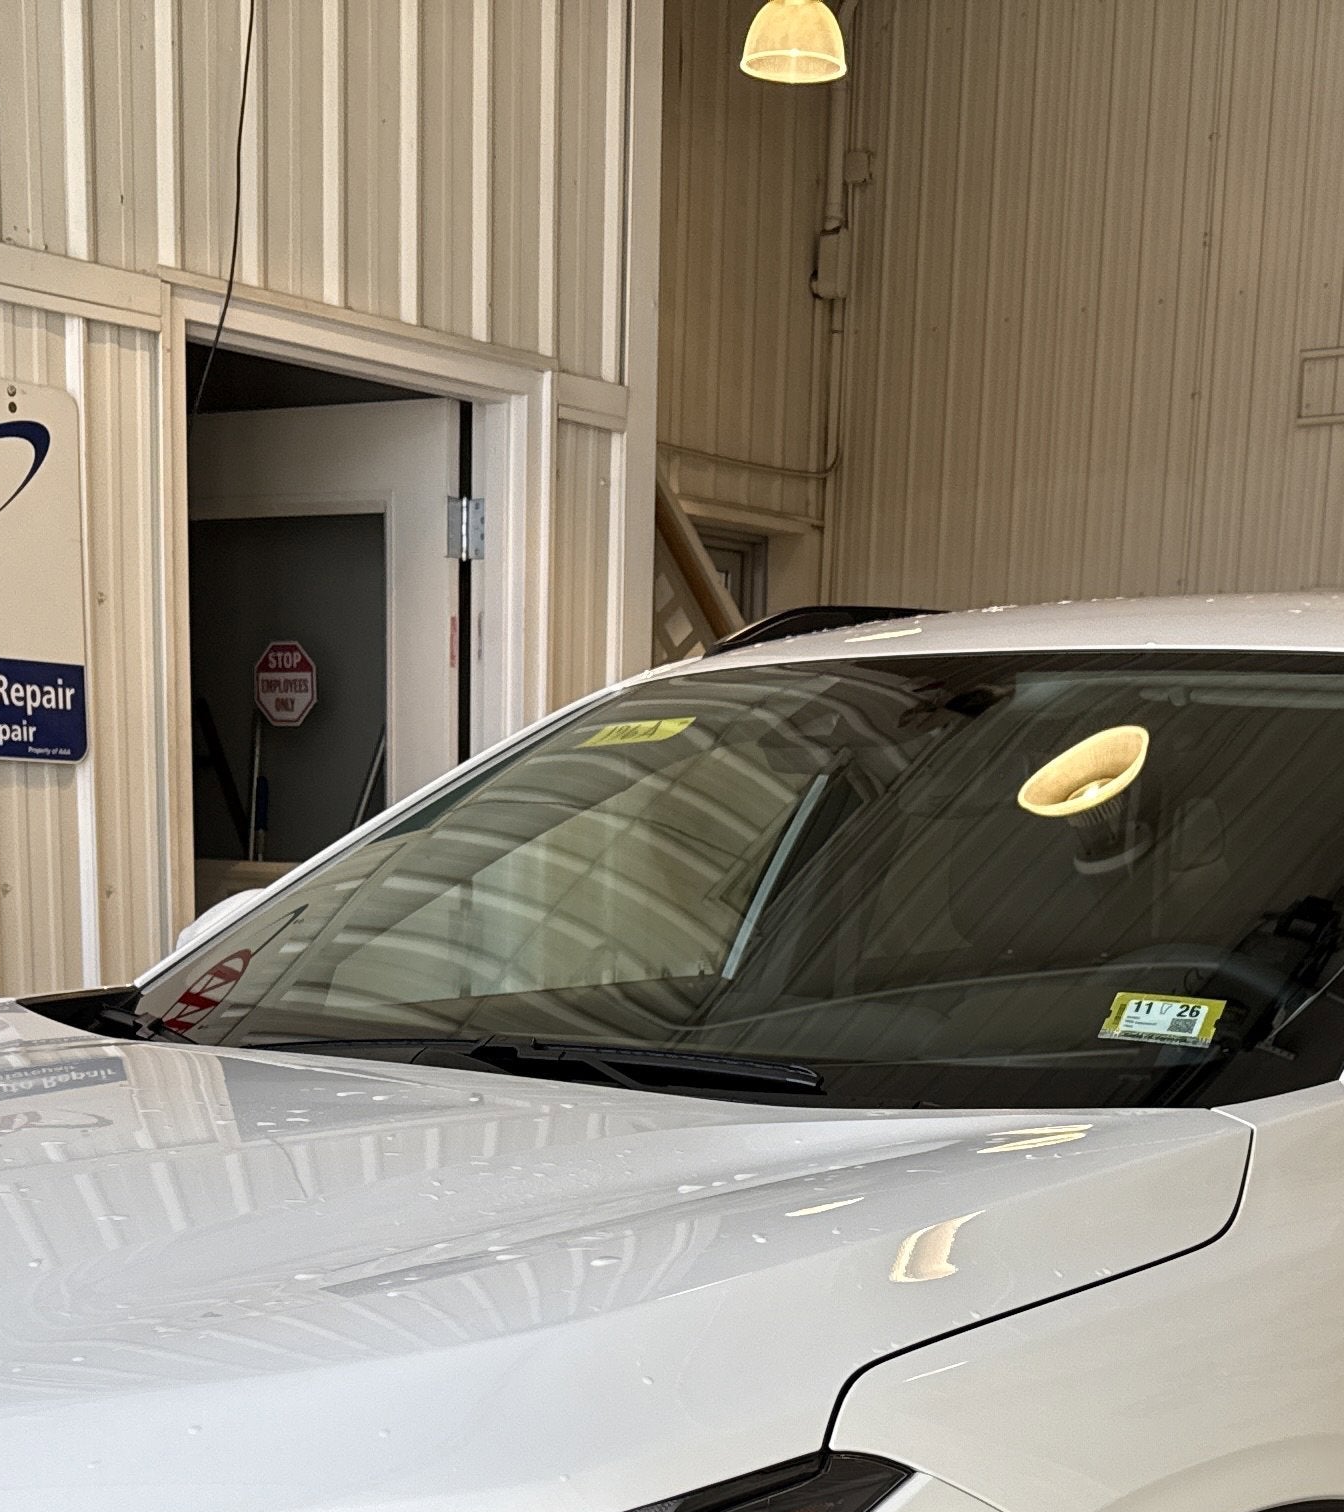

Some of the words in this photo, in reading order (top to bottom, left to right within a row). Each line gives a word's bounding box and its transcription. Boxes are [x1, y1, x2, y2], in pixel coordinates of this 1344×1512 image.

[268, 652, 302, 669] STOP
[260, 679, 309, 693] EMPLOYEES
[274, 698, 295, 712] ONLY
[1134, 1000, 1153, 1014] 11
[1176, 1004, 1201, 1018] 26
